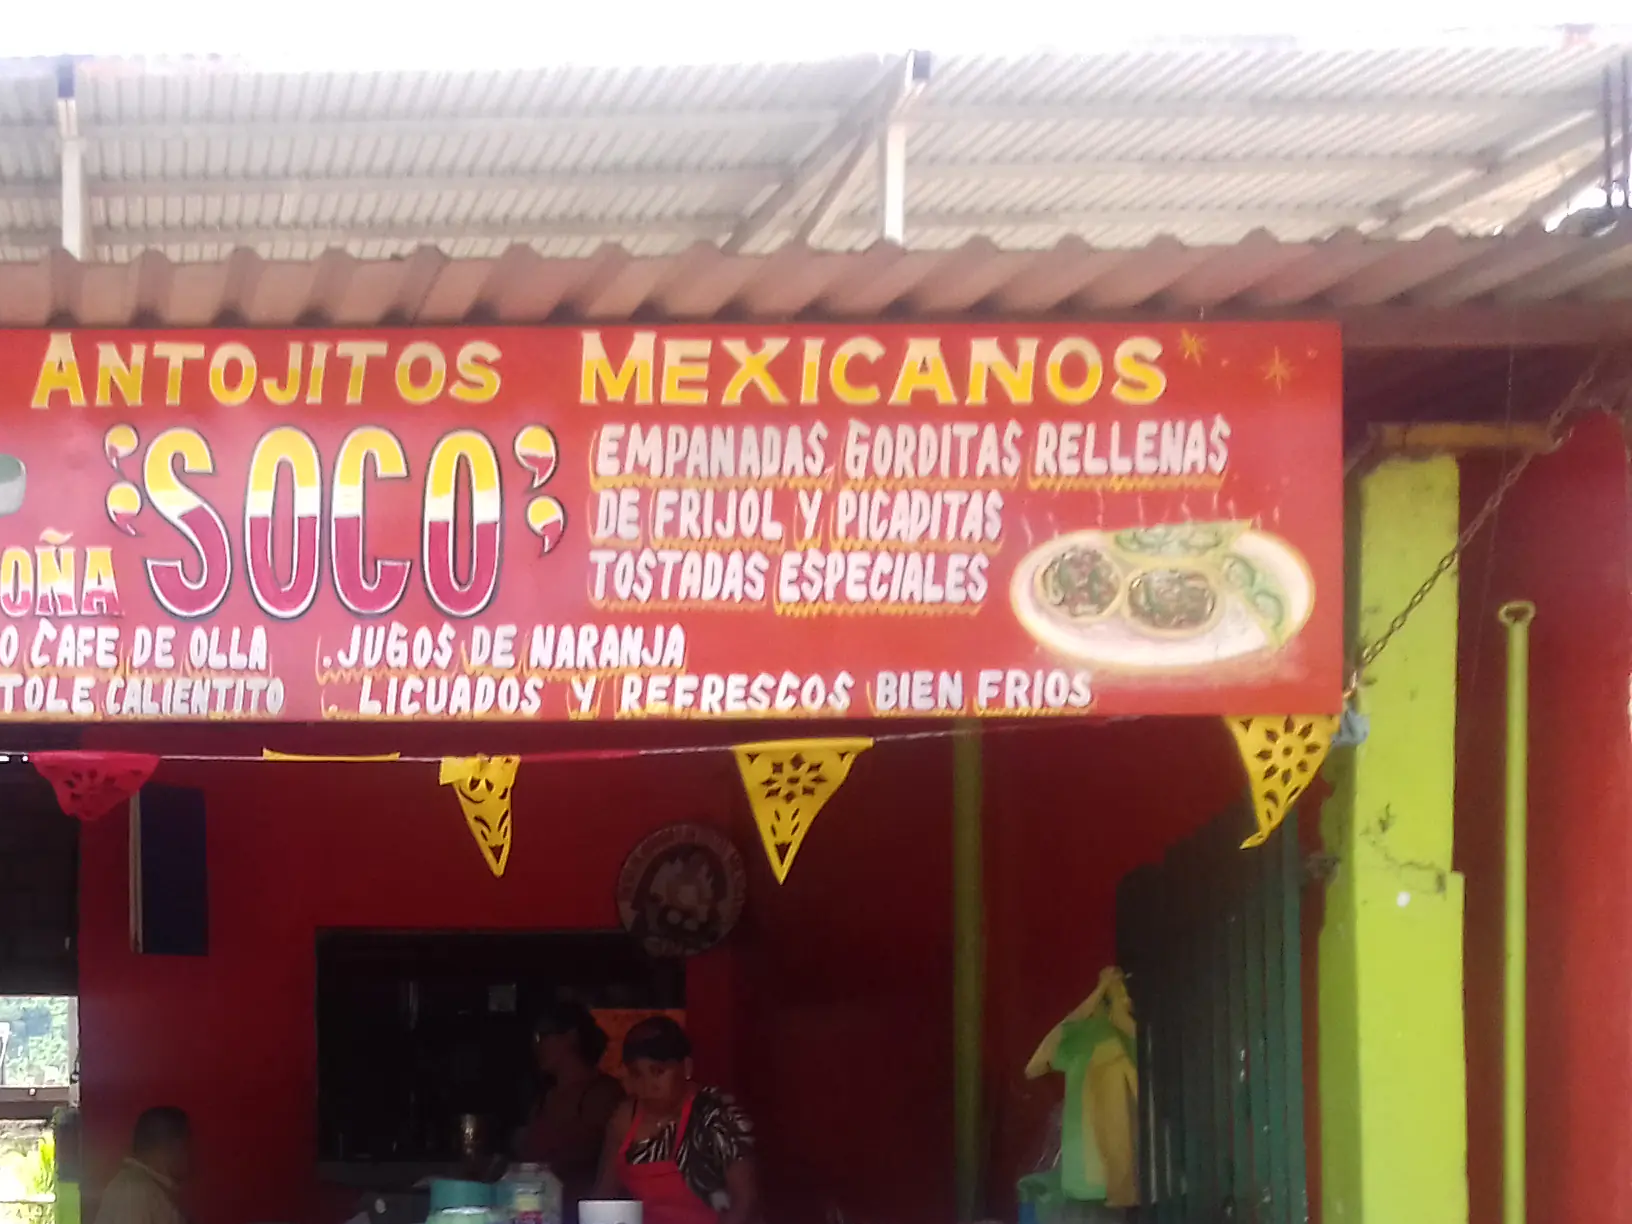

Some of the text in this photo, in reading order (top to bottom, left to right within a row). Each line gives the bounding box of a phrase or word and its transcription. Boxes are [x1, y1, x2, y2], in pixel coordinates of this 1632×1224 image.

[32, 332, 502, 408] ANTOJITOS
[580, 332, 1167, 406] MEXICANOS
[845, 420, 1020, 477] GORDITAS
[1034, 415, 1231, 476] RELLENAS
[595, 489, 1002, 542] DE FRIJOL Y PICADITAS
[589, 551, 989, 602] TOSTADAS ESPECIALES
[31, 618, 119, 670] CAFE
[132, 625, 176, 669] DE
[189, 626, 268, 670] OLLA
[472, 625, 516, 670] DE
[530, 624, 686, 671] NARANJA
[106, 677, 285, 716] CALIENTITO
[359, 669, 1093, 716] LICUADOS Y REFRESCOS BIEN FRIOS
